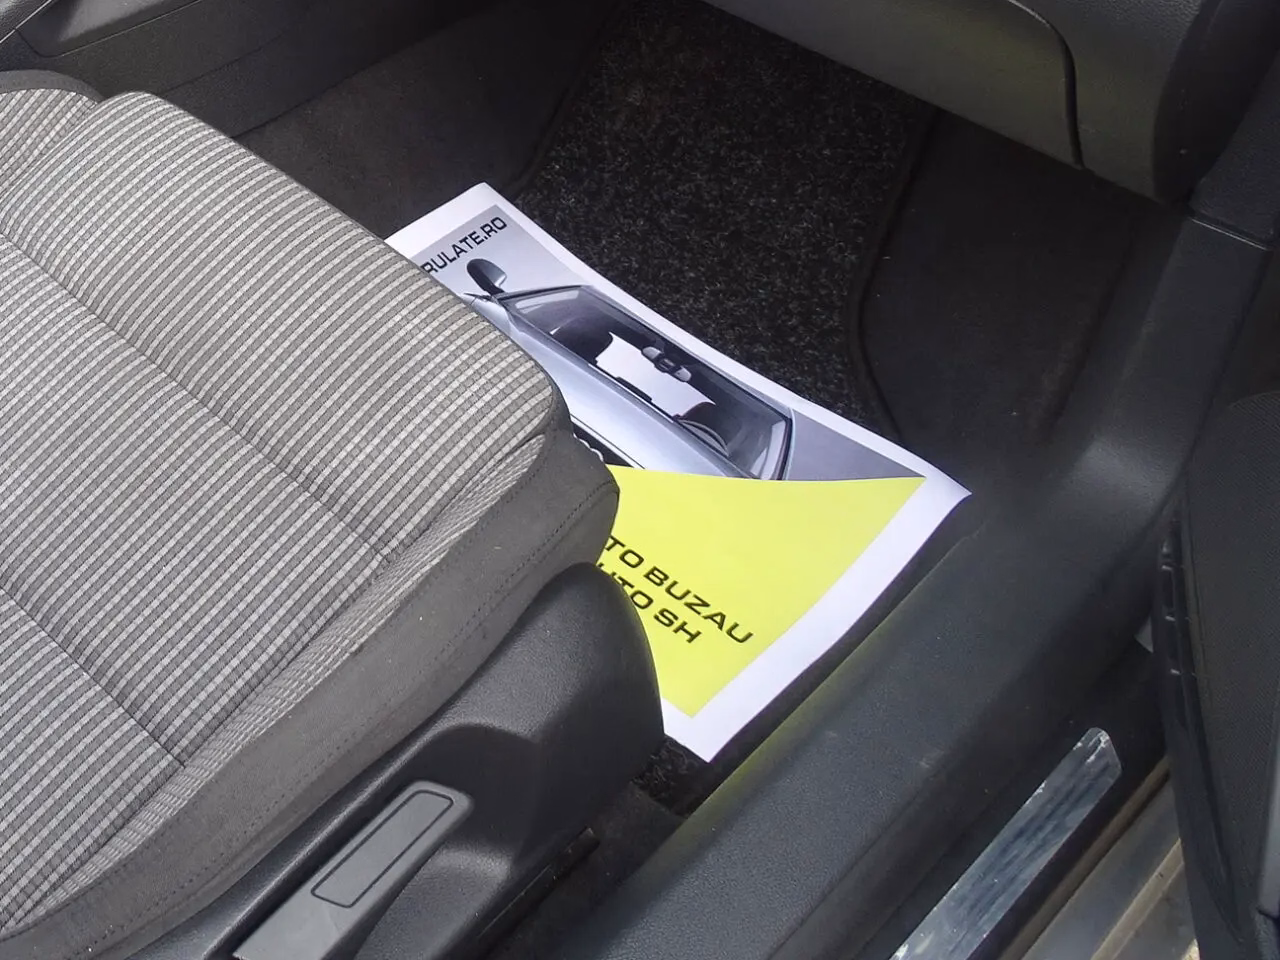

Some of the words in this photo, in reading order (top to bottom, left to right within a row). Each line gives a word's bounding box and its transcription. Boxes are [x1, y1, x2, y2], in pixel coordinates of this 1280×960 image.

[420, 216, 507, 274] RULATE.RO
[643, 566, 754, 644] BUZAU
[653, 607, 702, 644] SH
